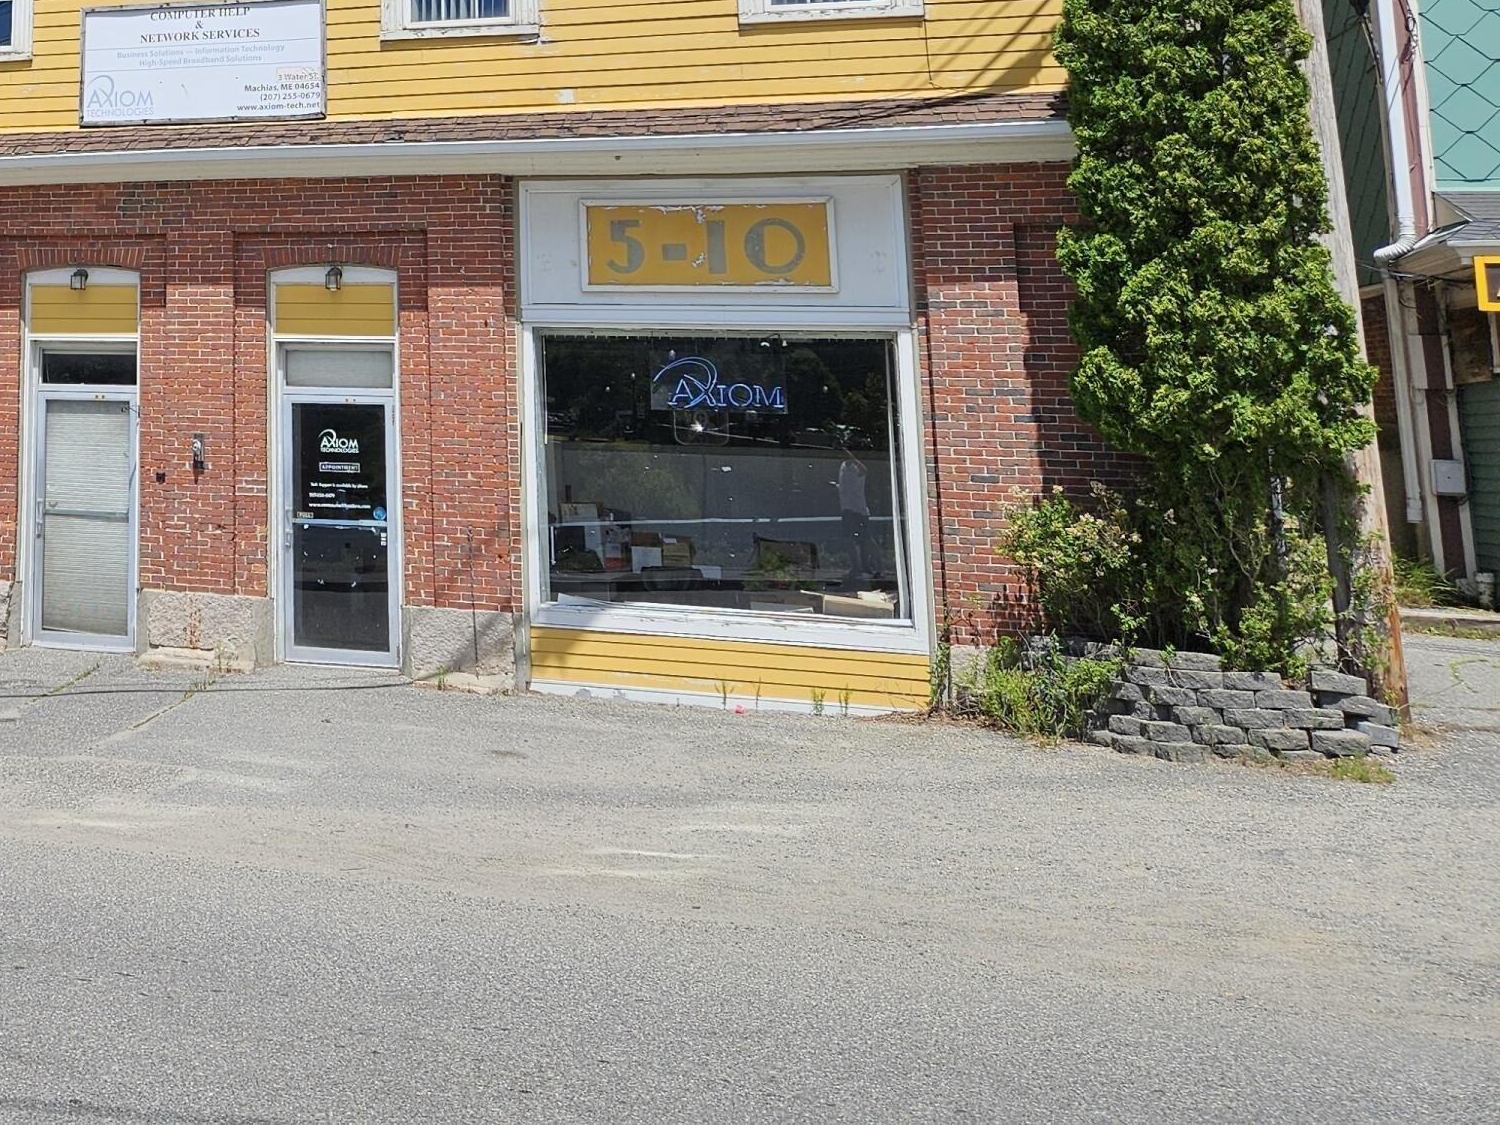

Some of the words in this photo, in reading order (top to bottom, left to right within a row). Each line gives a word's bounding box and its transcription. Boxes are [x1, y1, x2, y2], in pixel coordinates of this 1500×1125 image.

[150, 9, 216, 22] COMPUTER
[219, 6, 251, 18] HELP
[195, 20, 204, 30] &
[140, 31, 200, 44] NETWORK
[202, 28, 261, 41] SERVICES
[116, 51, 148, 60] Business
[150, 49, 184, 58] Solutions
[195, 46, 240, 56] Information
[242, 43, 285, 54] Technology
[139, 58, 182, 68] High-Speed
[184, 56, 225, 65] Broadband
[226, 54, 262, 63] Solutions
[284, 73, 308, 81] Water
[86, 75, 154, 108] AXIOM
[280, 83, 293, 91] ME
[294, 81, 320, 90] 04654
[260, 93, 281, 102] (207)
[282, 91, 321, 101] 255-0679
[86, 106, 155, 118] TECHNOLOGIES
[236, 101, 320, 111] www.axiom-tech.net
[606, 218, 806, 275] 5-10
[653, 357, 786, 408] AXIOM
[319, 429, 359, 448] AXIOM
